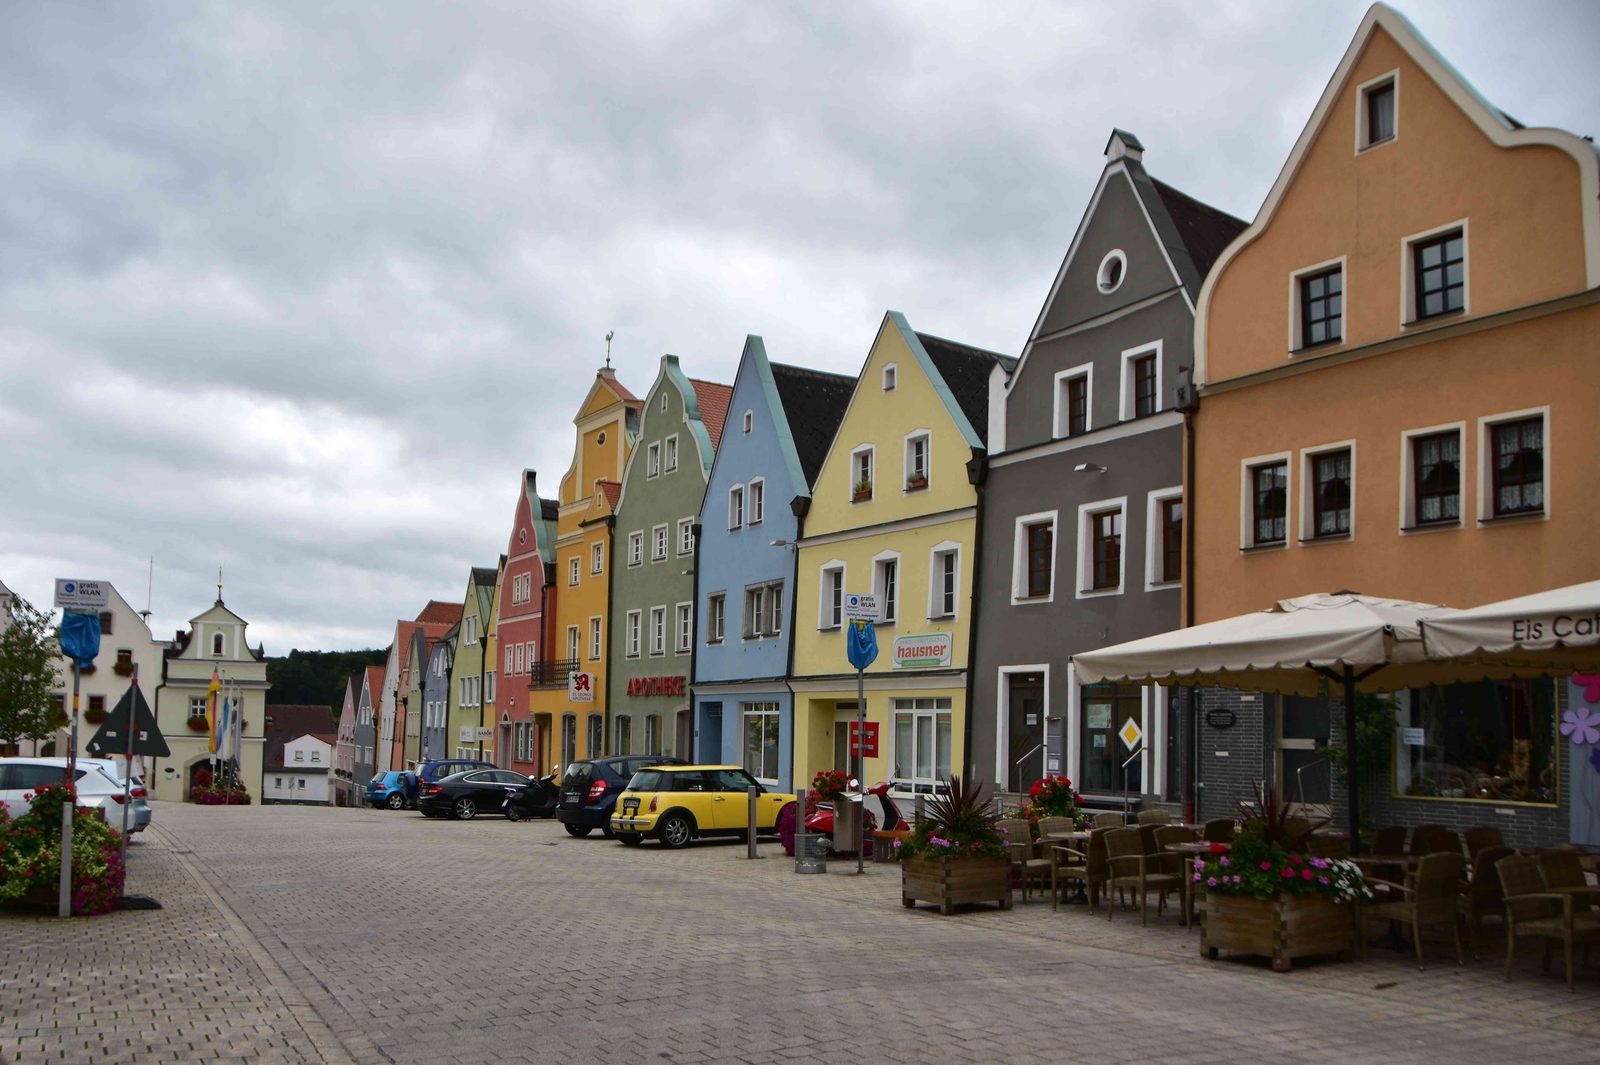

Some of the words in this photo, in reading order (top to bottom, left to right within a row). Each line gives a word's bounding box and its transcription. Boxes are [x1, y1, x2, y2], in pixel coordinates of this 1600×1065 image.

[79, 582, 99, 590] gratis
[1512, 619, 1543, 641] Eis
[897, 644, 947, 658] hausner
[626, 676, 686, 697] APOTHEKE
